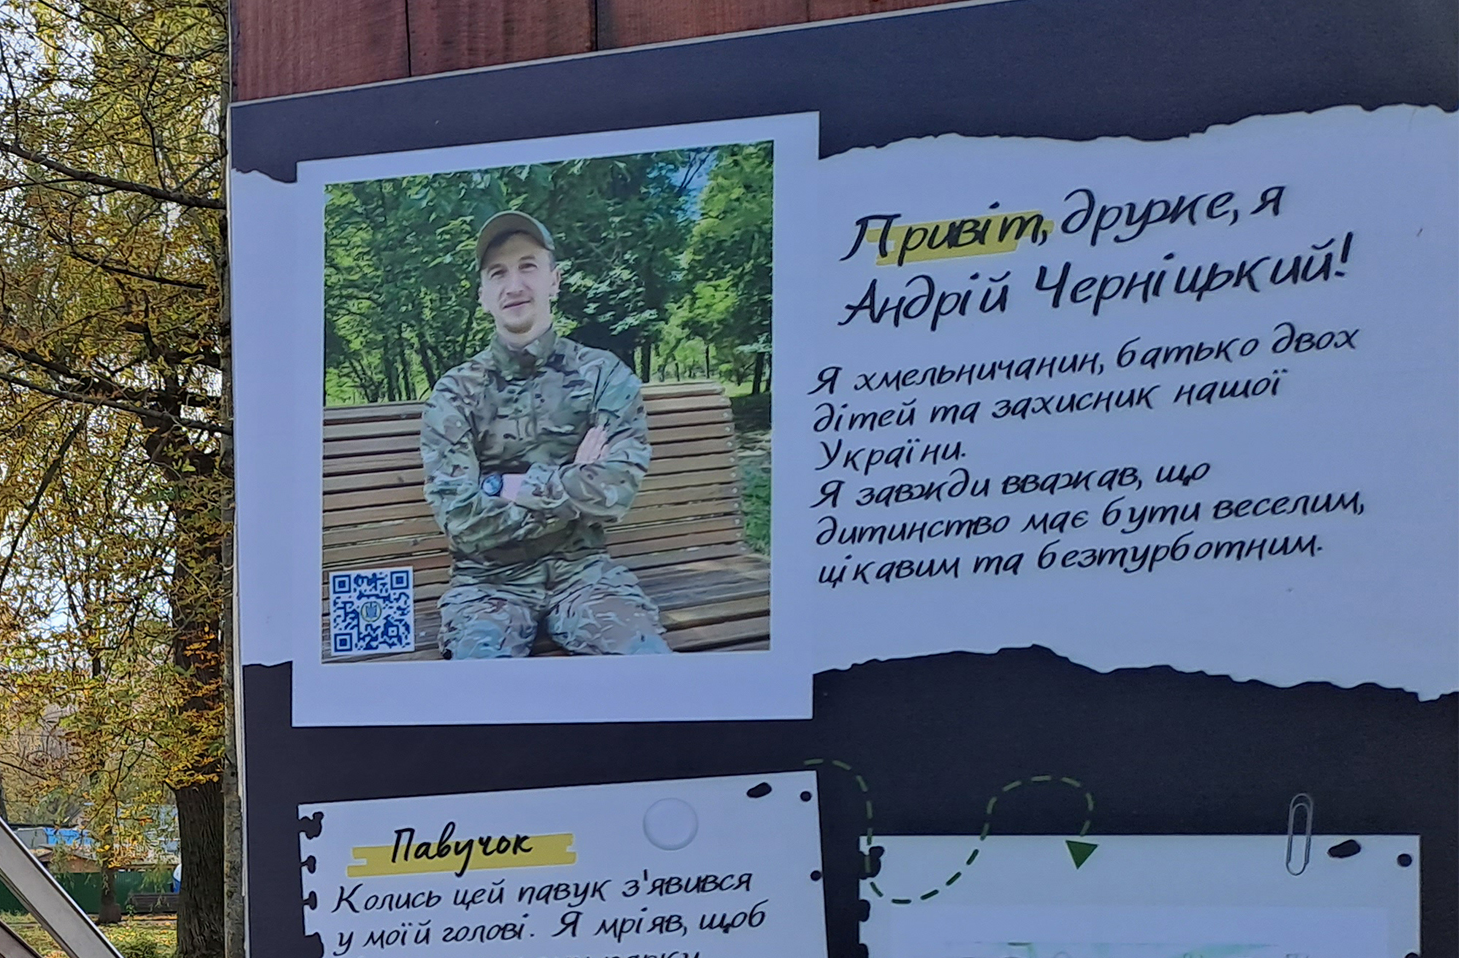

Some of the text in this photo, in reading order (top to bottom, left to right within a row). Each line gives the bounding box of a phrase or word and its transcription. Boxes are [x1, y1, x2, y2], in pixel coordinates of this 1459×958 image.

[841, 185, 1286, 264] Привіт, друже, я
[837, 232, 1354, 331] Андрій Черніцький!
[807, 322, 1359, 396] Я хмельничанин, батько двох
[813, 369, 1288, 433] дітей та захисник нашої
[812, 461, 1211, 509] Я завжди вважав, що
[815, 438, 966, 476] України.
[815, 491, 1365, 548] дитинство має бути веселим,
[818, 533, 1323, 587] цікавим та безтурботним.
[391, 823, 533, 876] Павучок
[332, 869, 753, 913] Колись цей павук з'явився
[333, 900, 768, 956] у моїй голові. Я мріяв, щоб
